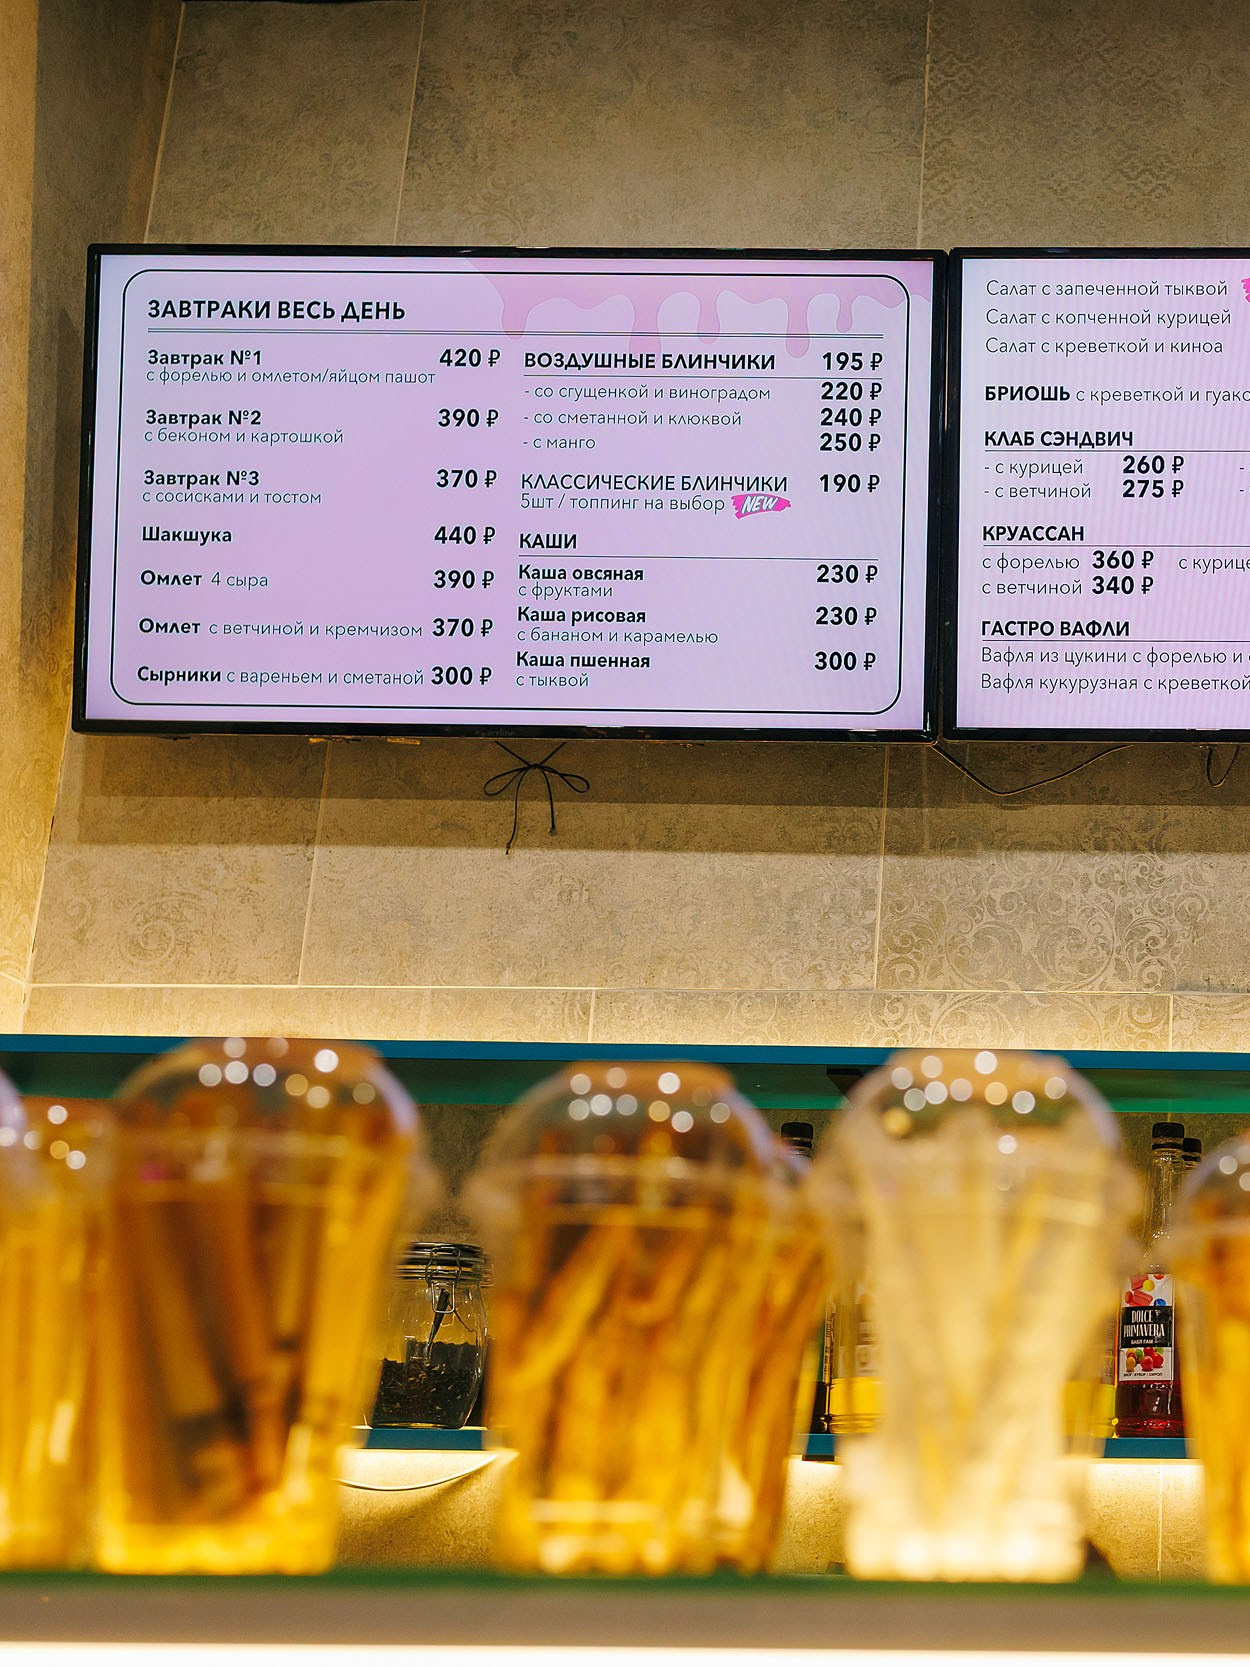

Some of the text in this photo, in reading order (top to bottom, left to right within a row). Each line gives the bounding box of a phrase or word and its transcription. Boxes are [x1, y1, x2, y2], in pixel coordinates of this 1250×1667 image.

[987, 280, 1226, 295] Салат с запеченной тыквой
[148, 300, 405, 322] ЗАВТРАКИ ВЕСЬ ДЕНЬ
[148, 350, 260, 369] Завтрак №1
[440, 349, 481, 367] 420
[525, 353, 774, 370] ВОЗДУШНЫЕ БЛИНЧИКИ
[823, 352, 862, 370] 195
[147, 367, 435, 385] с форелью и омлетом/яйцом пашот
[986, 386, 1070, 401] БРИОШЬ
[1077, 391, 1084, 401] с
[1091, 387, 1183, 405] креветкой
[1190, 391, 1199, 401] и
[146, 410, 261, 429] Завтрак №2
[985, 431, 1132, 449] КЛАБ СЭНДВИЧ
[144, 470, 259, 489] Завтрак №3
[522, 474, 787, 491] КЛАССИЧЕСКИЕ БЛИНЧИКИ
[740, 494, 778, 514] NEW
[143, 527, 231, 546] Шакшука
[435, 526, 476, 544] 440
[520, 534, 576, 549] КАШИ
[983, 526, 1083, 541] КРУАССАН
[983, 553, 1079, 573] с форелью
[141, 570, 267, 590] Омлет 4 сыра
[519, 565, 643, 580] Каша овсяная
[817, 564, 858, 583] 230
[519, 581, 612, 600] с фруктами
[518, 607, 645, 626] Каша рисовая
[982, 620, 1129, 637] ГАСТРО ВАФЛИ
[517, 673, 588, 686] с тыквой
[1131, 1309, 1153, 1323] DOLCE
[1123, 1323, 1165, 1337] PRIMAVERA
